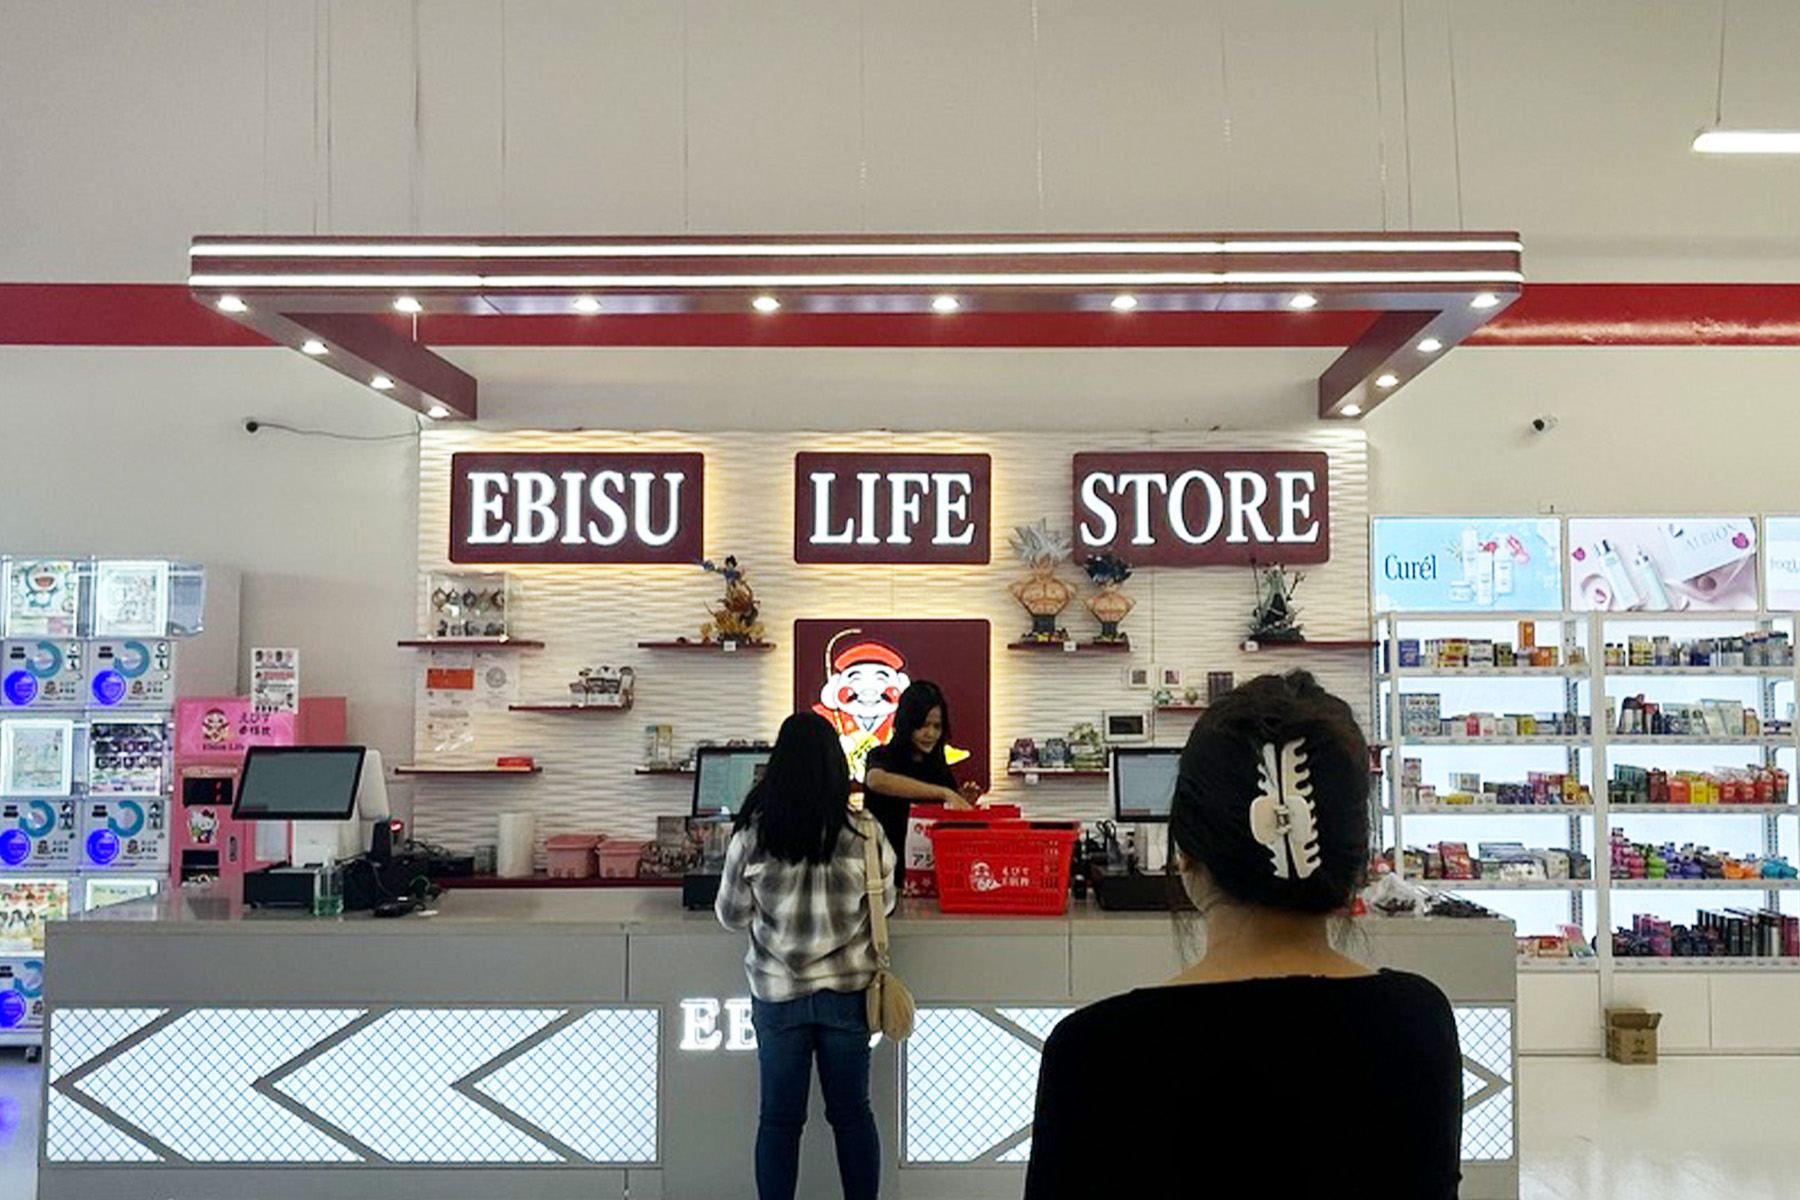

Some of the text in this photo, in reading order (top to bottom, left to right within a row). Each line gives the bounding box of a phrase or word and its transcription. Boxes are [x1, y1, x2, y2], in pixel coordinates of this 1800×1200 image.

[466, 469, 1319, 547] EBISU LIFE STORE
[1384, 554, 1437, 580] Curél
